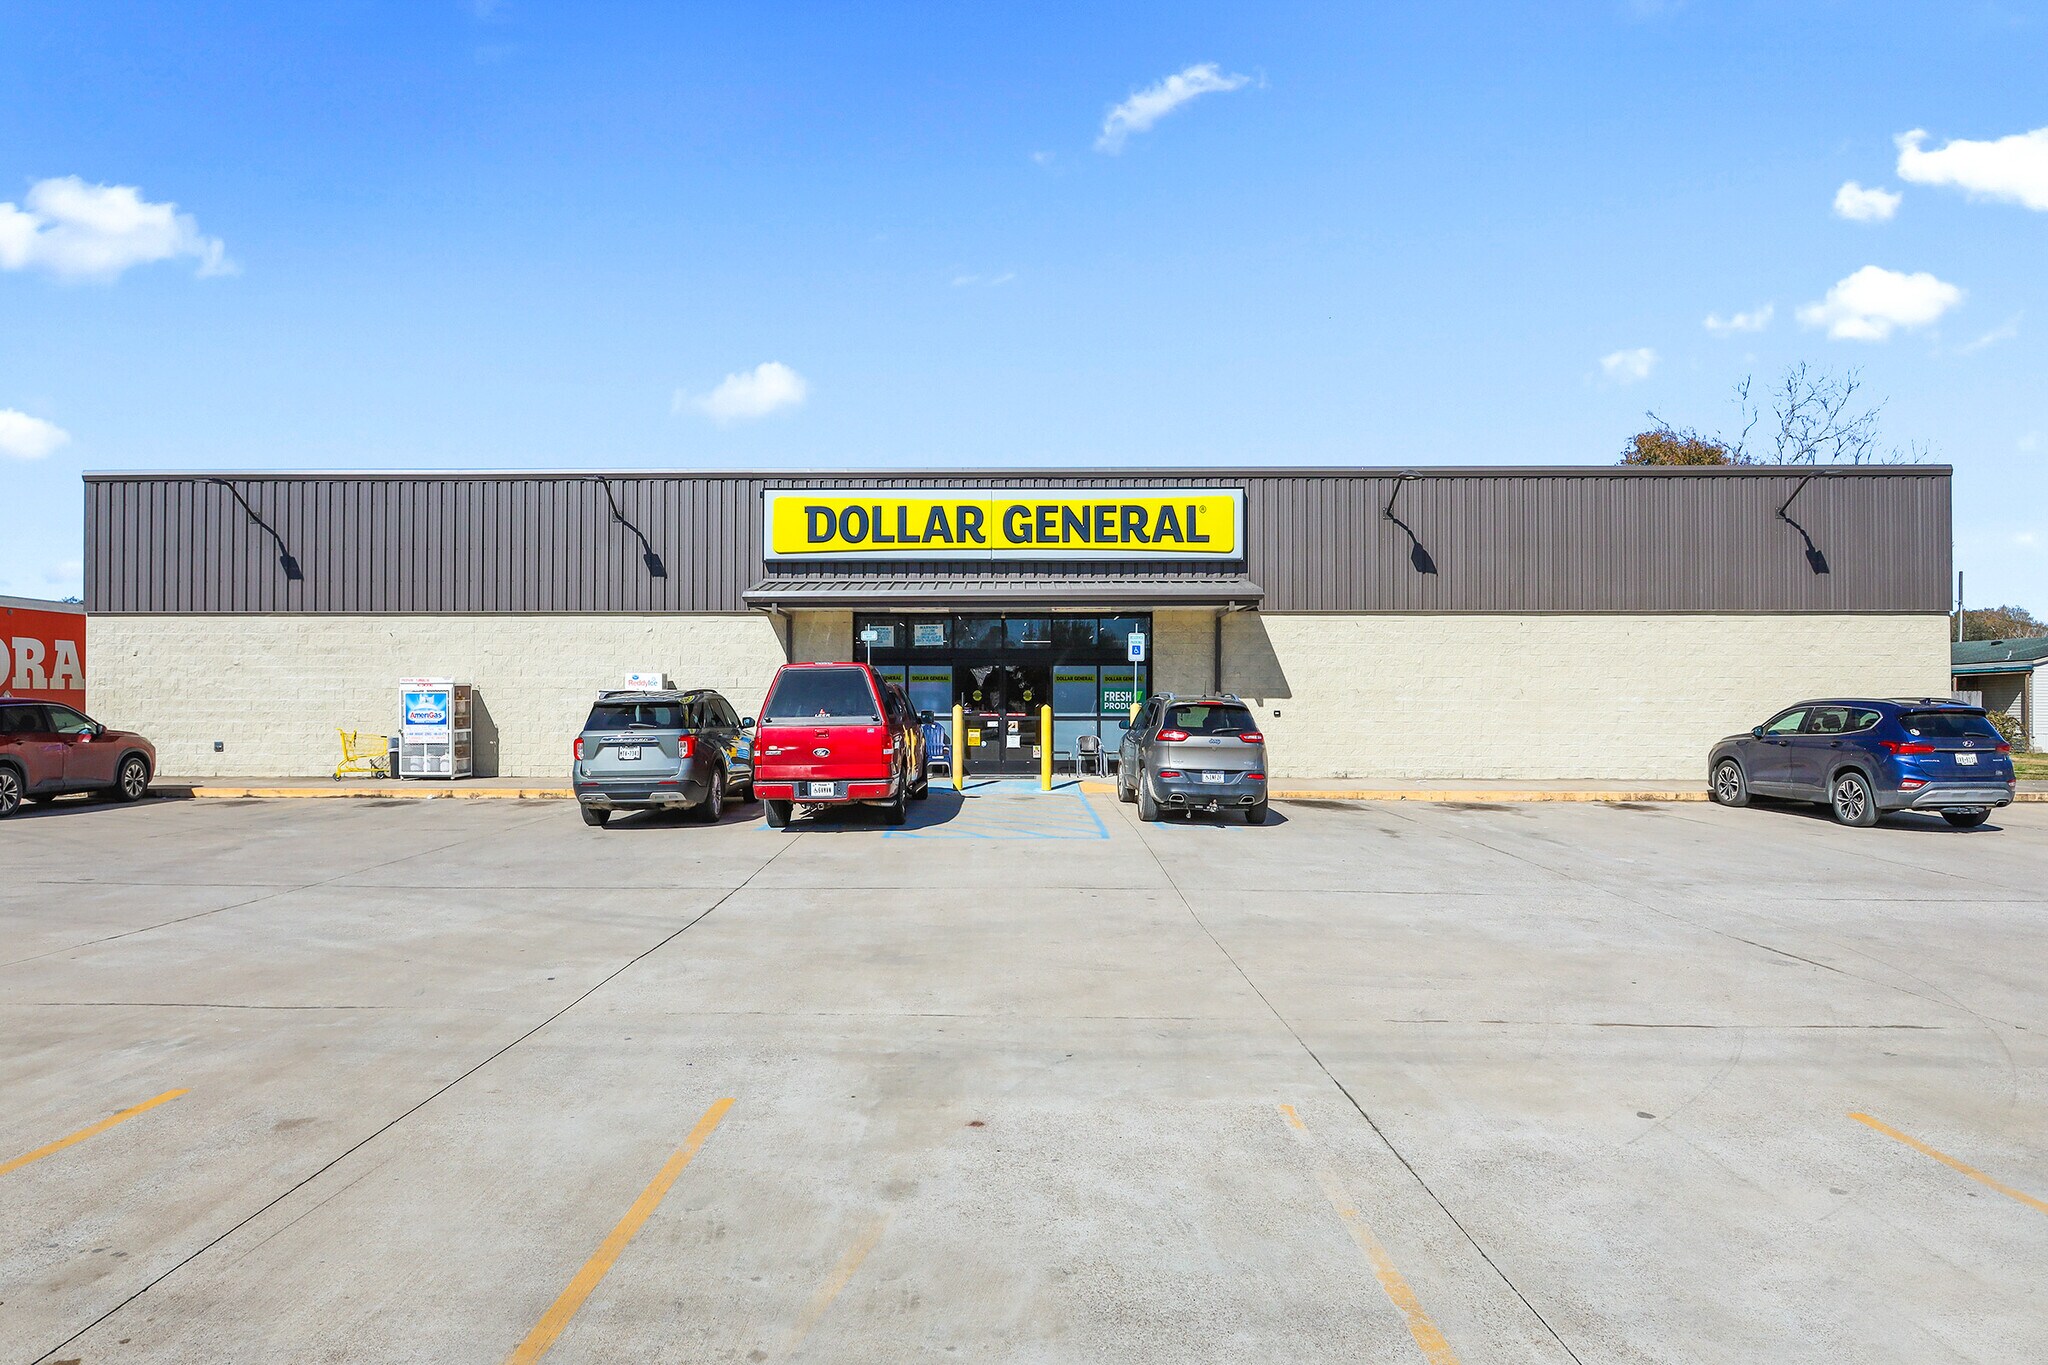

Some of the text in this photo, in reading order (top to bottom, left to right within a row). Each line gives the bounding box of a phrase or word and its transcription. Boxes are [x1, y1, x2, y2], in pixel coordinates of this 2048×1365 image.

[804, 505, 987, 544] DOLLAR
[0, 636, 86, 690] RA
[1104, 691, 1132, 702] FRESH
[410, 711, 442, 719] AmeriGas
